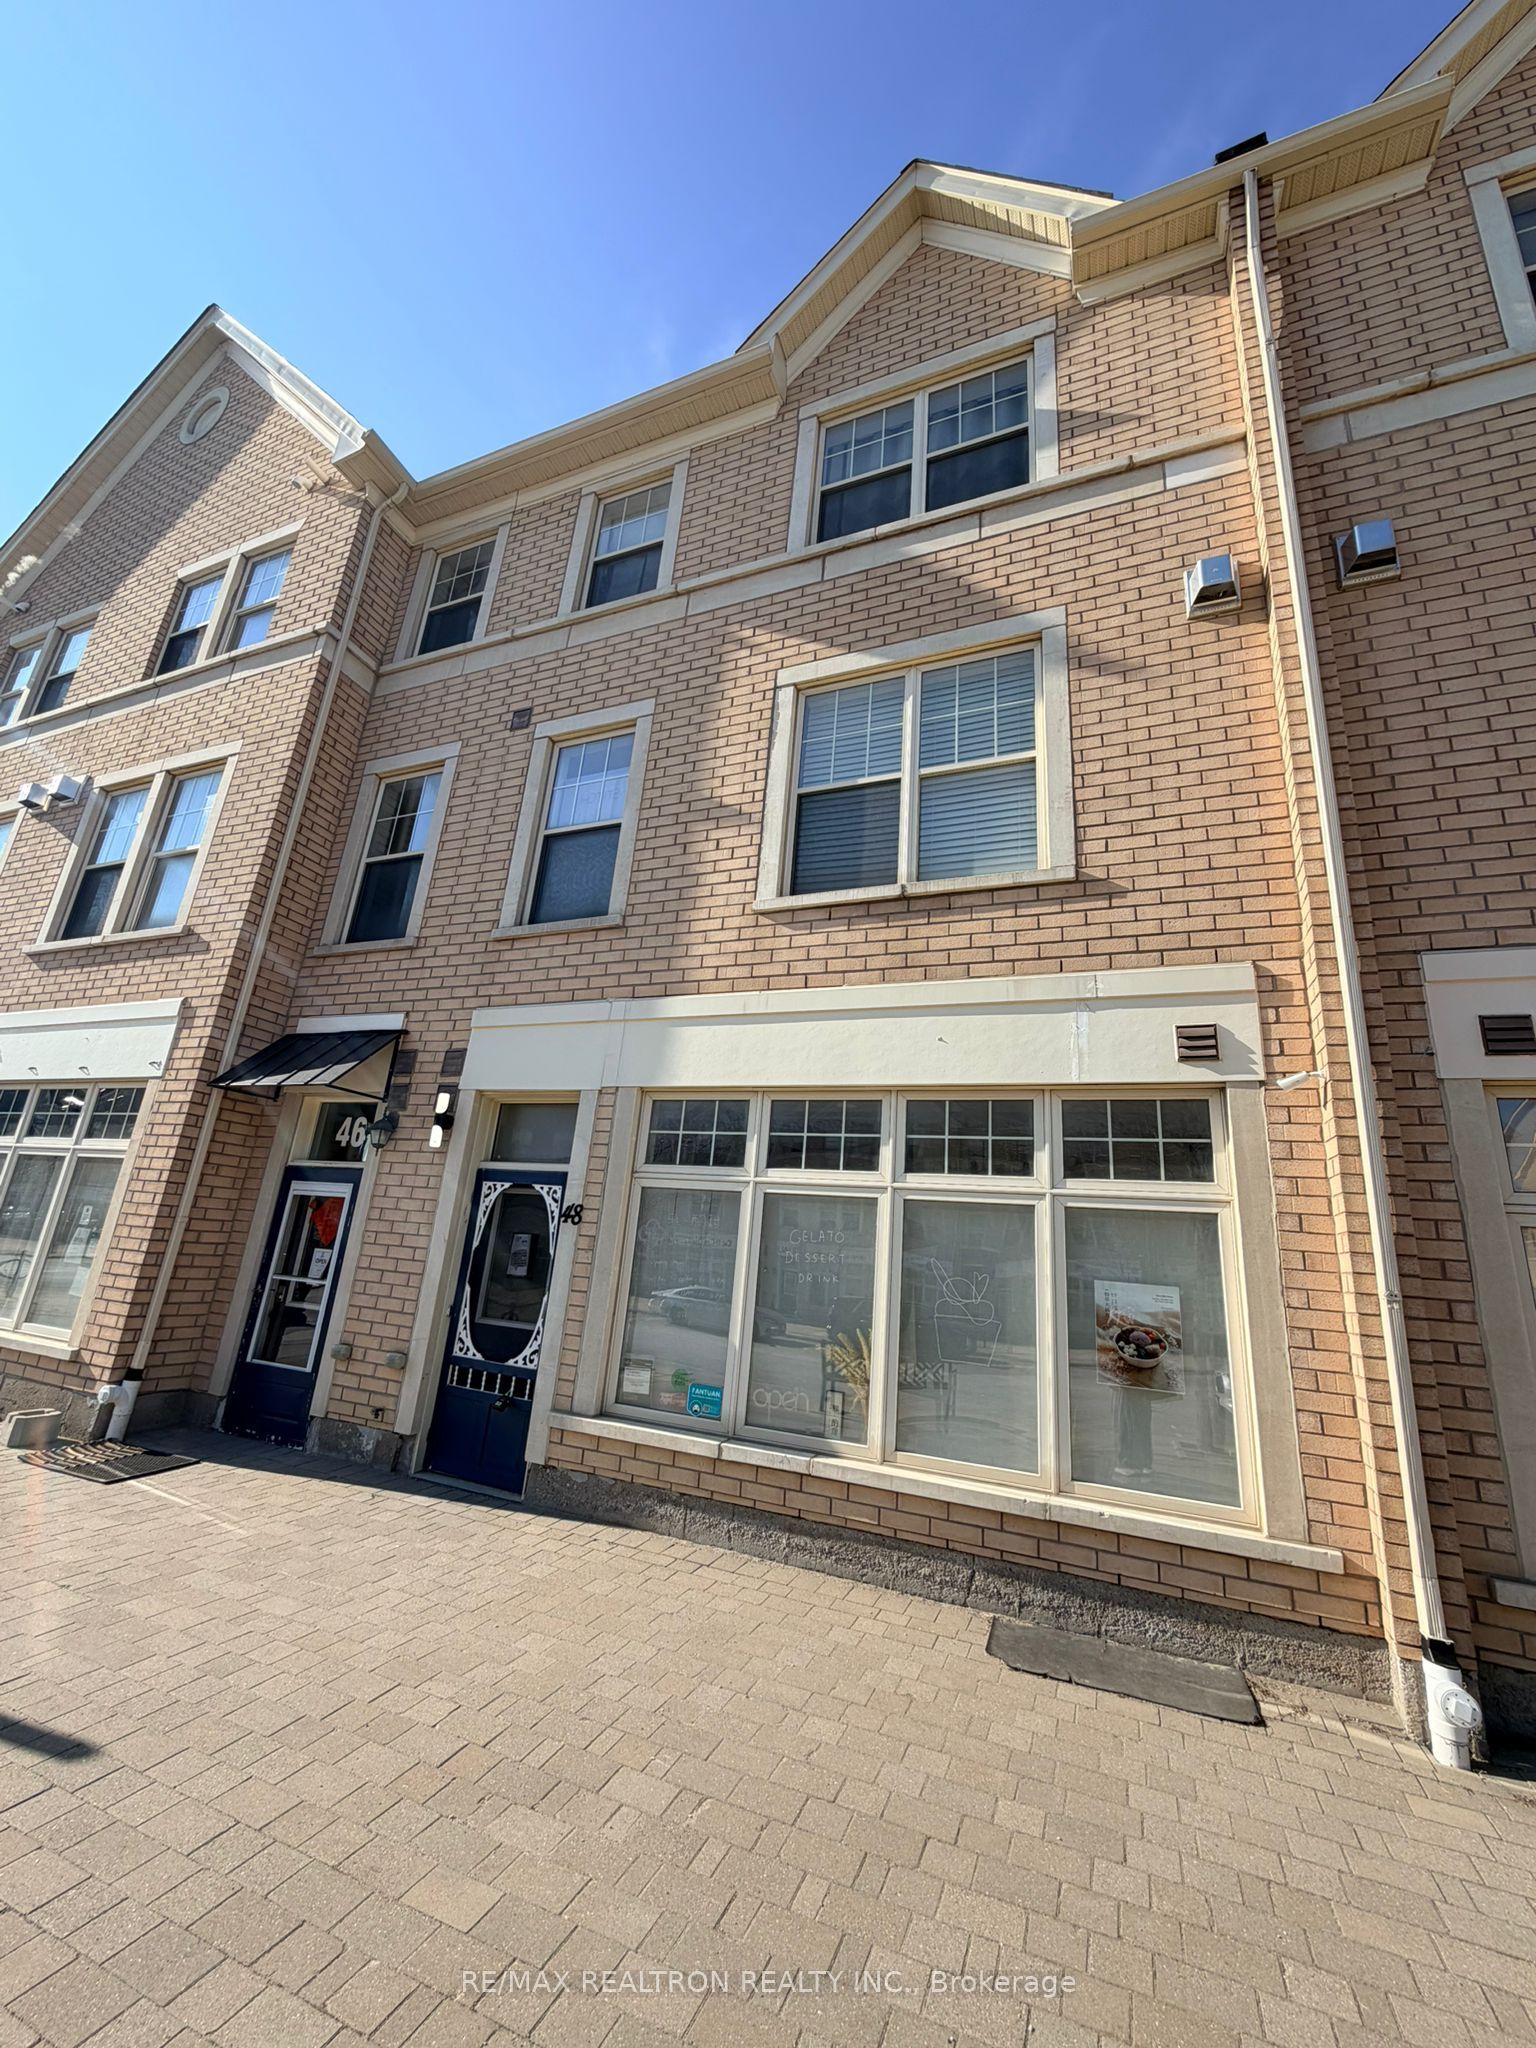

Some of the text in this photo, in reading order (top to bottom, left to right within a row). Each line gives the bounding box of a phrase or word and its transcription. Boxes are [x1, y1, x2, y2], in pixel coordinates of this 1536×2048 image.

[335, 1116, 368, 1148] 46
[560, 1203, 583, 1226] 48
[790, 1229, 845, 1245] GELATO
[785, 1250, 845, 1265] DESSERT
[798, 1273, 840, 1284] DRINK
[753, 1388, 810, 1422] open
